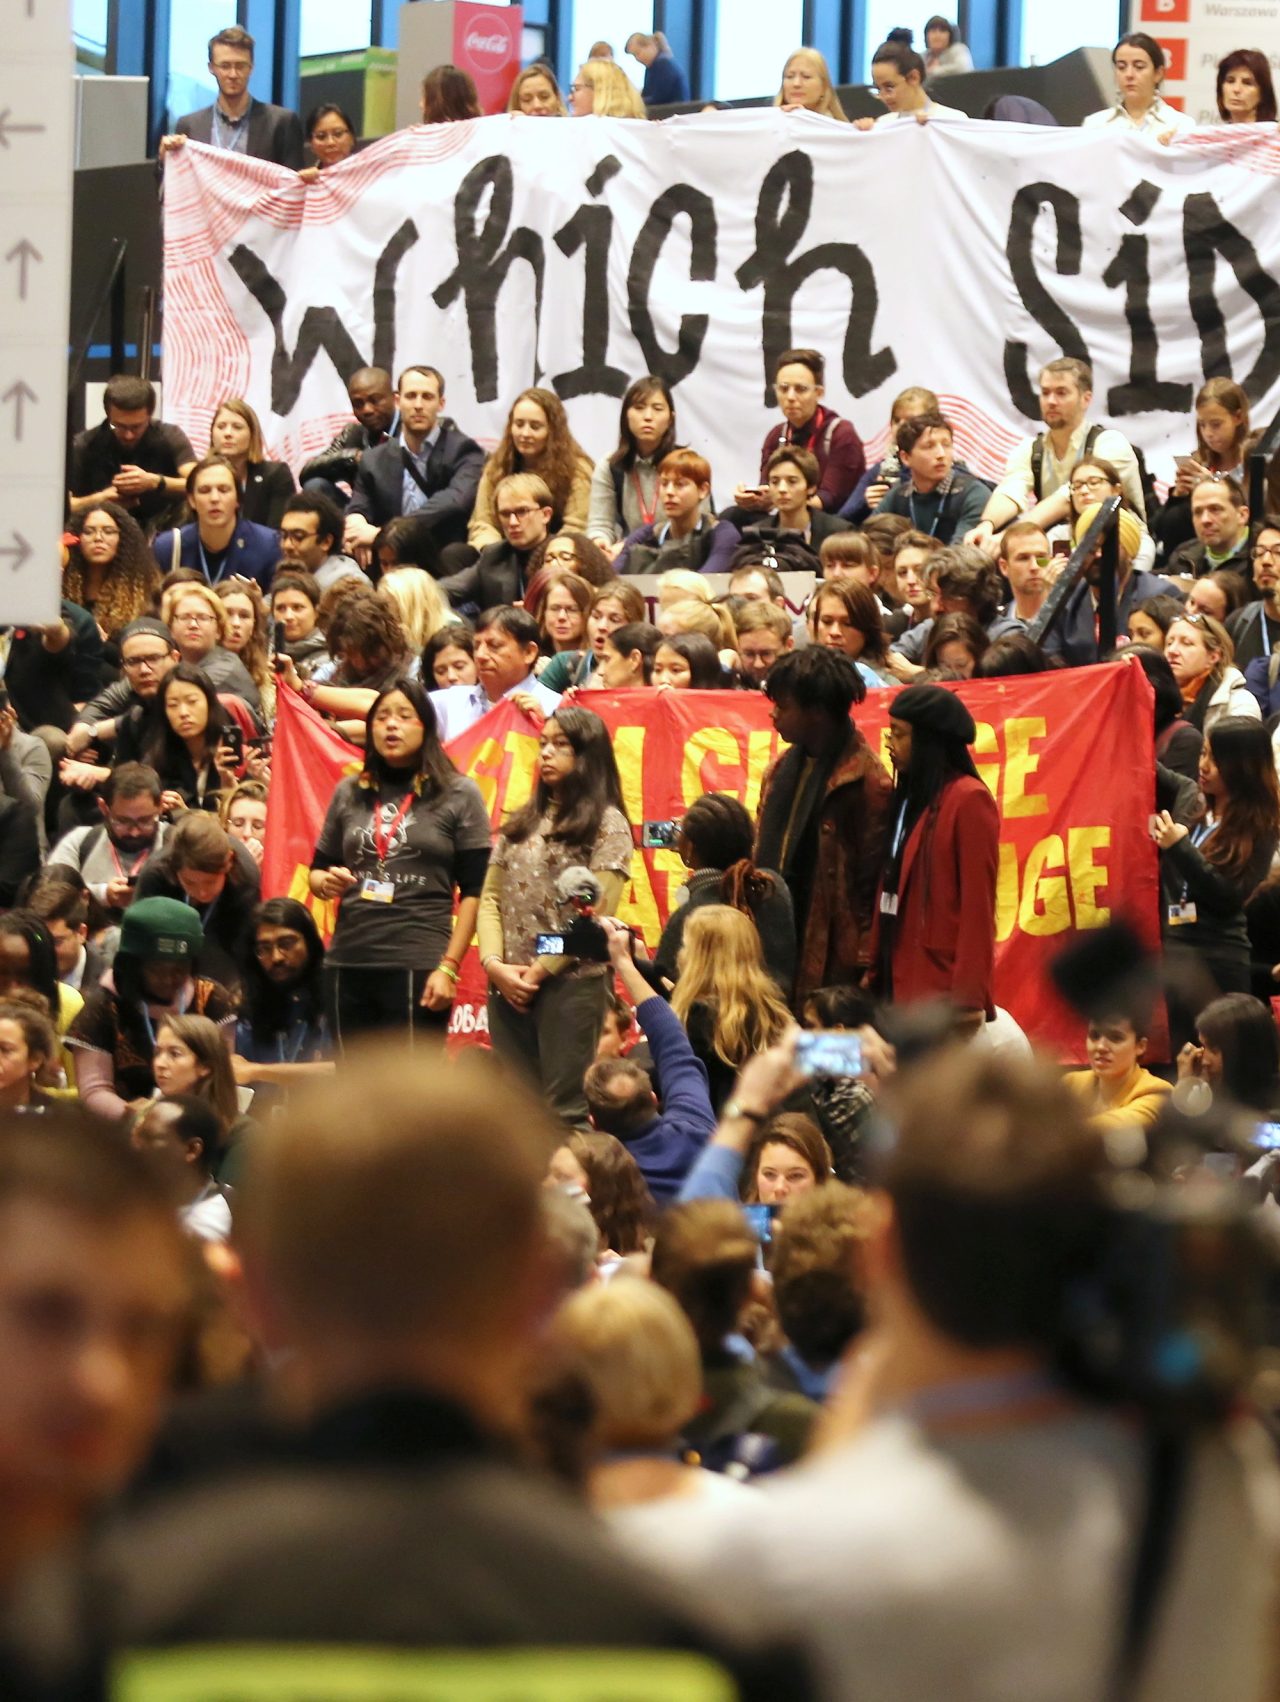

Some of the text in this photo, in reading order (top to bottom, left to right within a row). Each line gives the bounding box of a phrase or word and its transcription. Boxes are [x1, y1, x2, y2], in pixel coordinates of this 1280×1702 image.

[1204, 3, 1278, 17] Warszawa
[396, 873, 427, 886] LIFE
[448, 1003, 490, 1034] OBA
